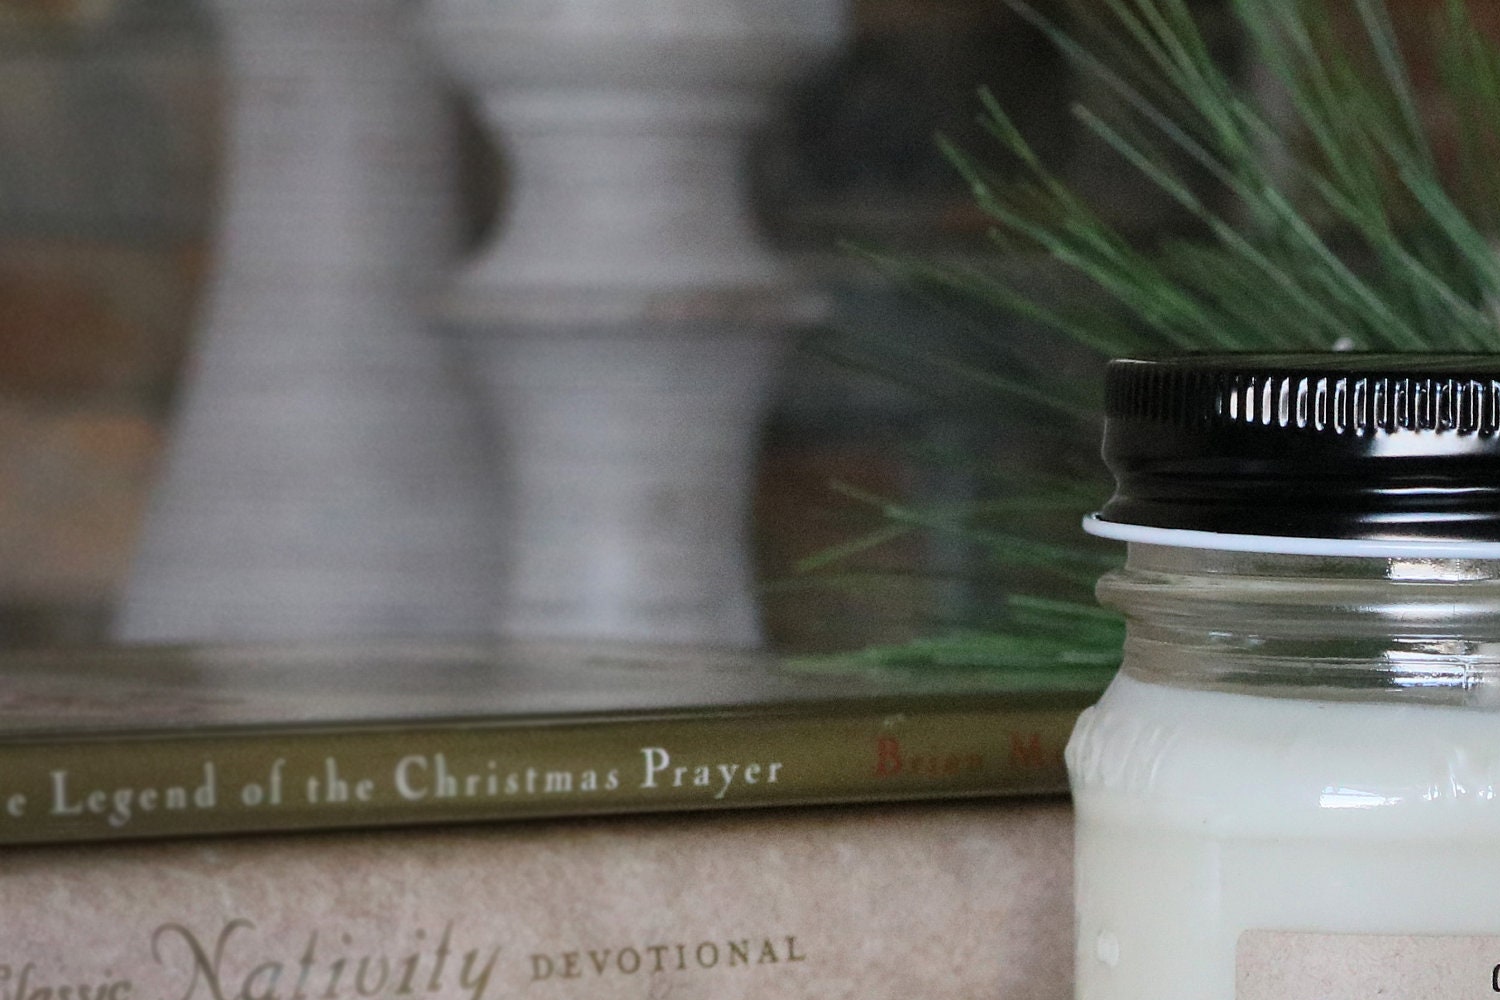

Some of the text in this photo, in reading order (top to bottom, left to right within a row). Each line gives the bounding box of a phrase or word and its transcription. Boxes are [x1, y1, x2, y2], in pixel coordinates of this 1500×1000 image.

[50, 769, 217, 828] Legend
[242, 759, 286, 804] of
[306, 757, 374, 803] the
[394, 754, 620, 800] Christmas
[640, 747, 784, 798] Prayer
[529, 935, 807, 983] DEVOTIONAL
